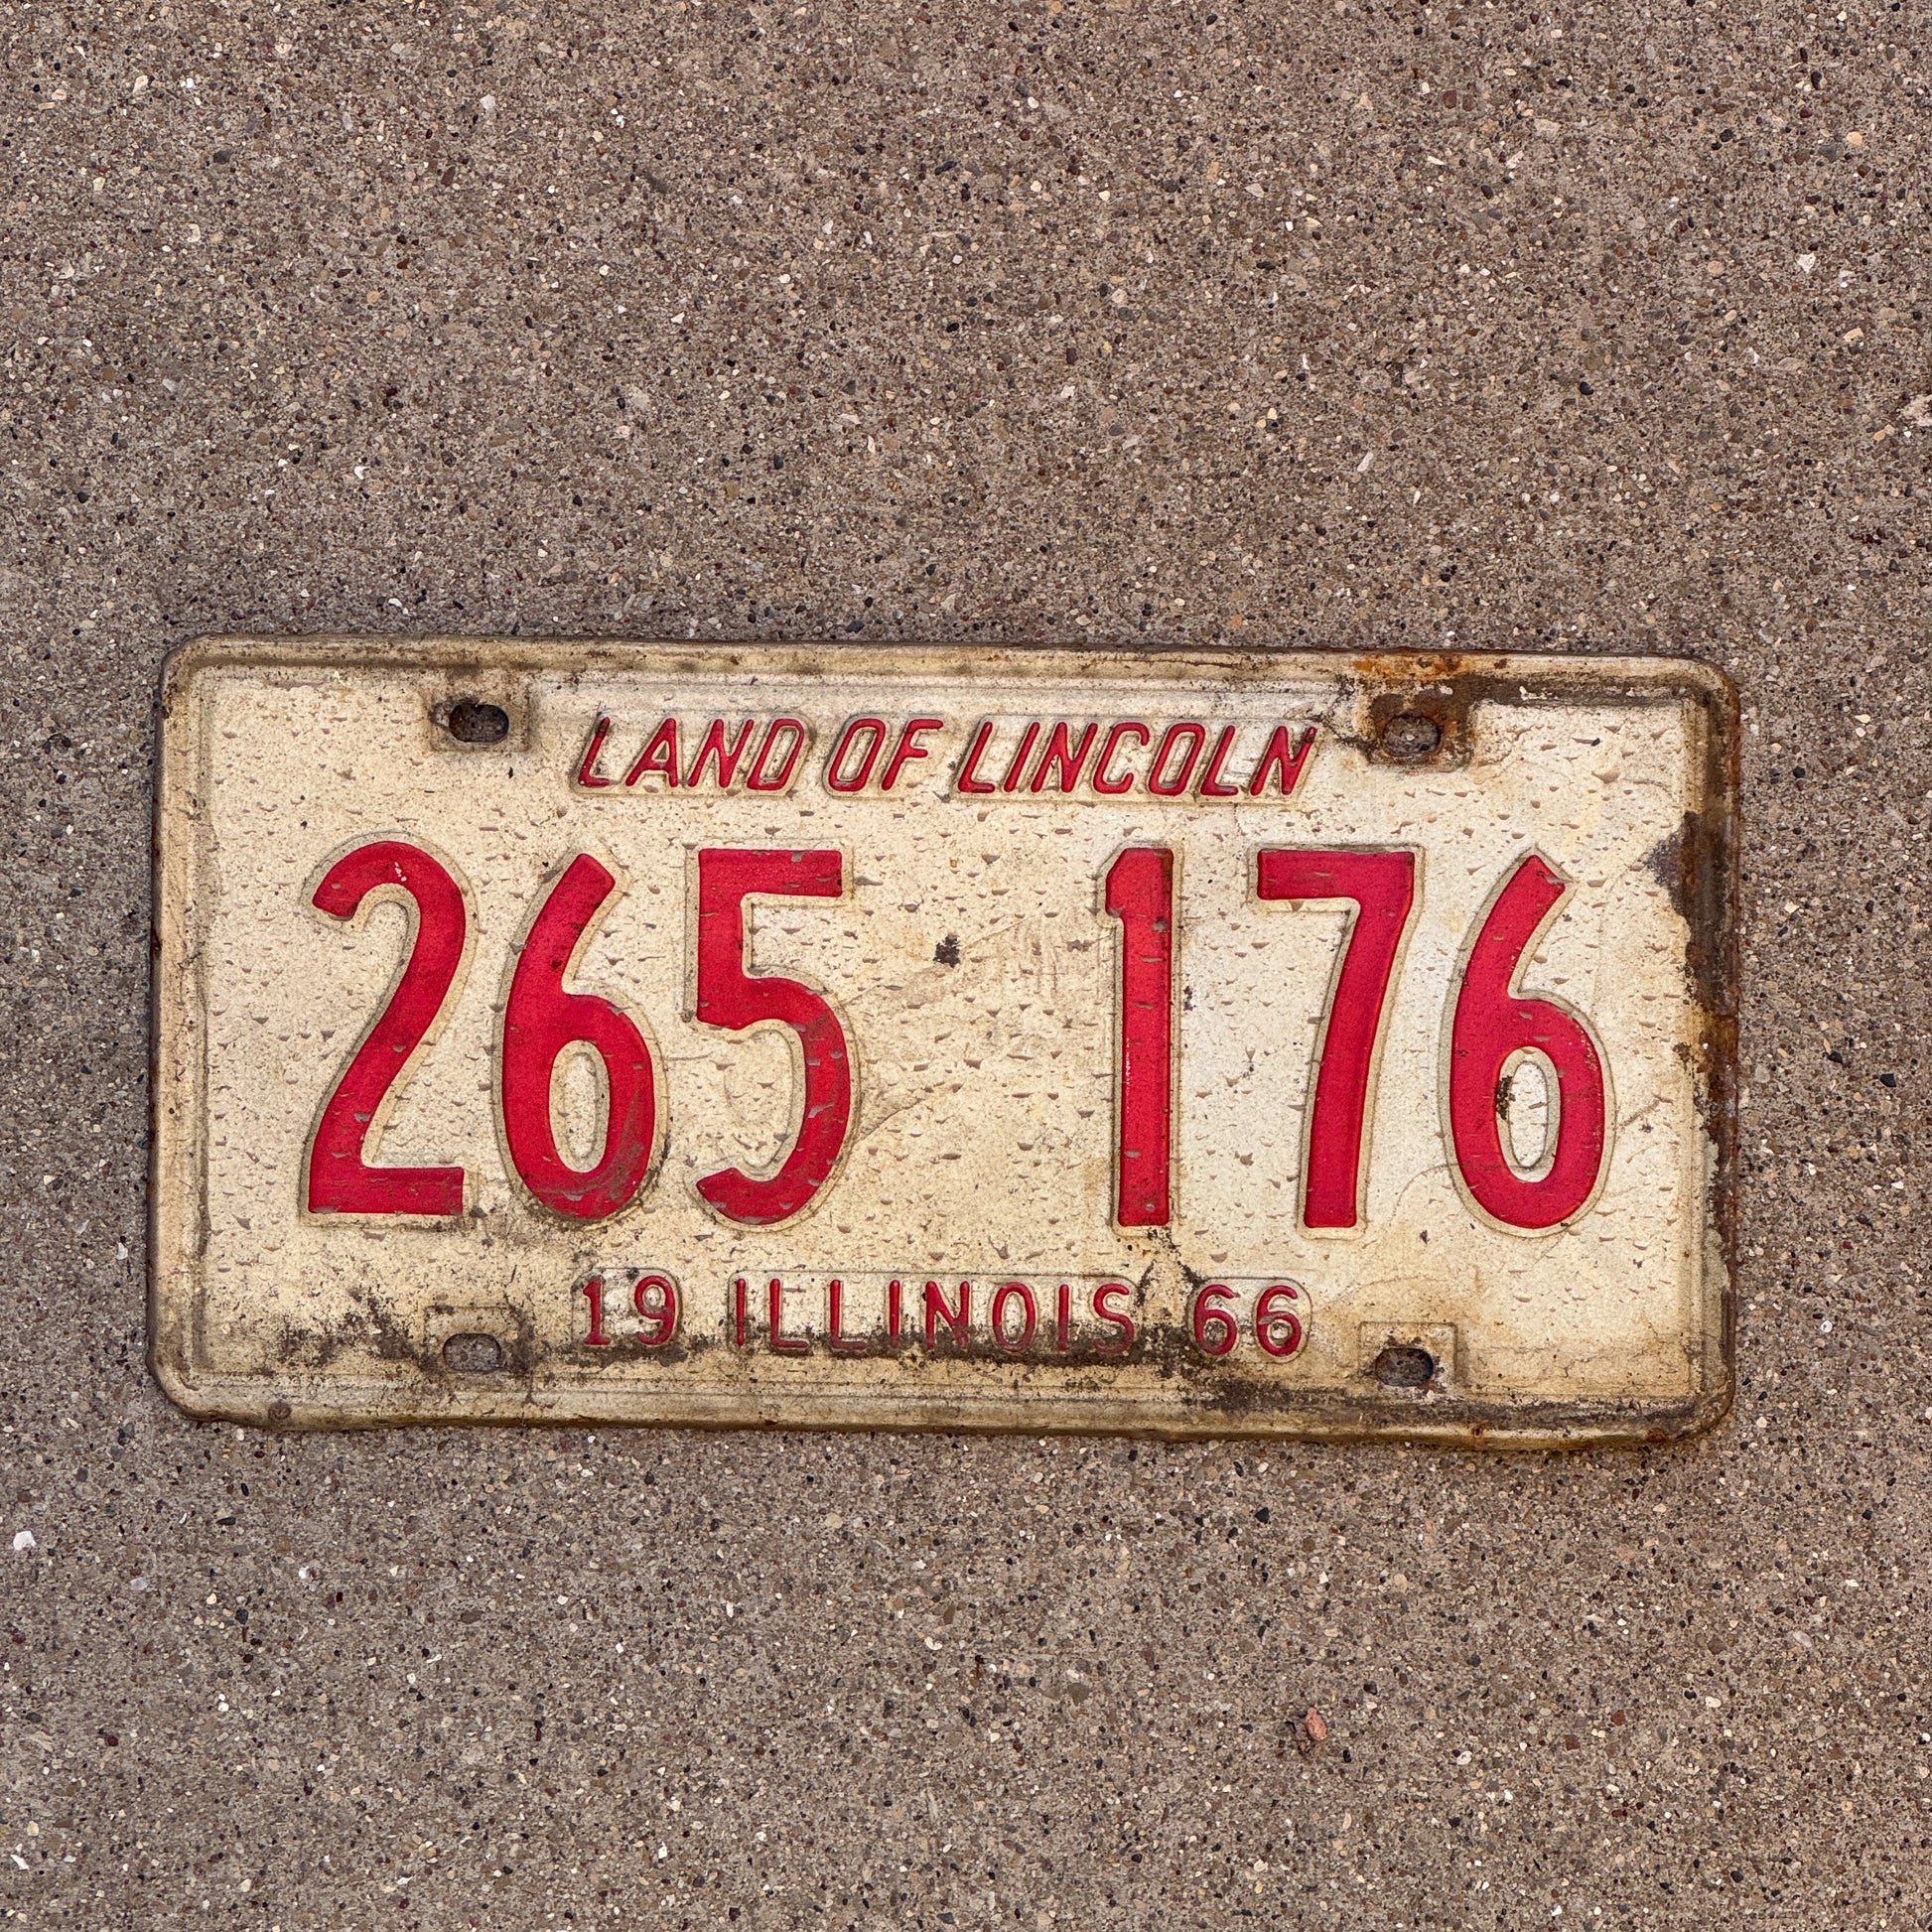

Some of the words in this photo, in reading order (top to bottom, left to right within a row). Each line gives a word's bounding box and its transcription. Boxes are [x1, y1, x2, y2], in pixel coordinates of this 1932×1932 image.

[578, 716, 806, 792] LAND
[827, 717, 945, 793] OF
[956, 721, 1316, 798] LINCOLN
[306, 839, 855, 1227] 265
[1103, 847, 1606, 1231] 176
[581, 1274, 677, 1347] 19
[734, 1277, 1136, 1354] ILLINOIS
[1192, 1283, 1303, 1358] 66
